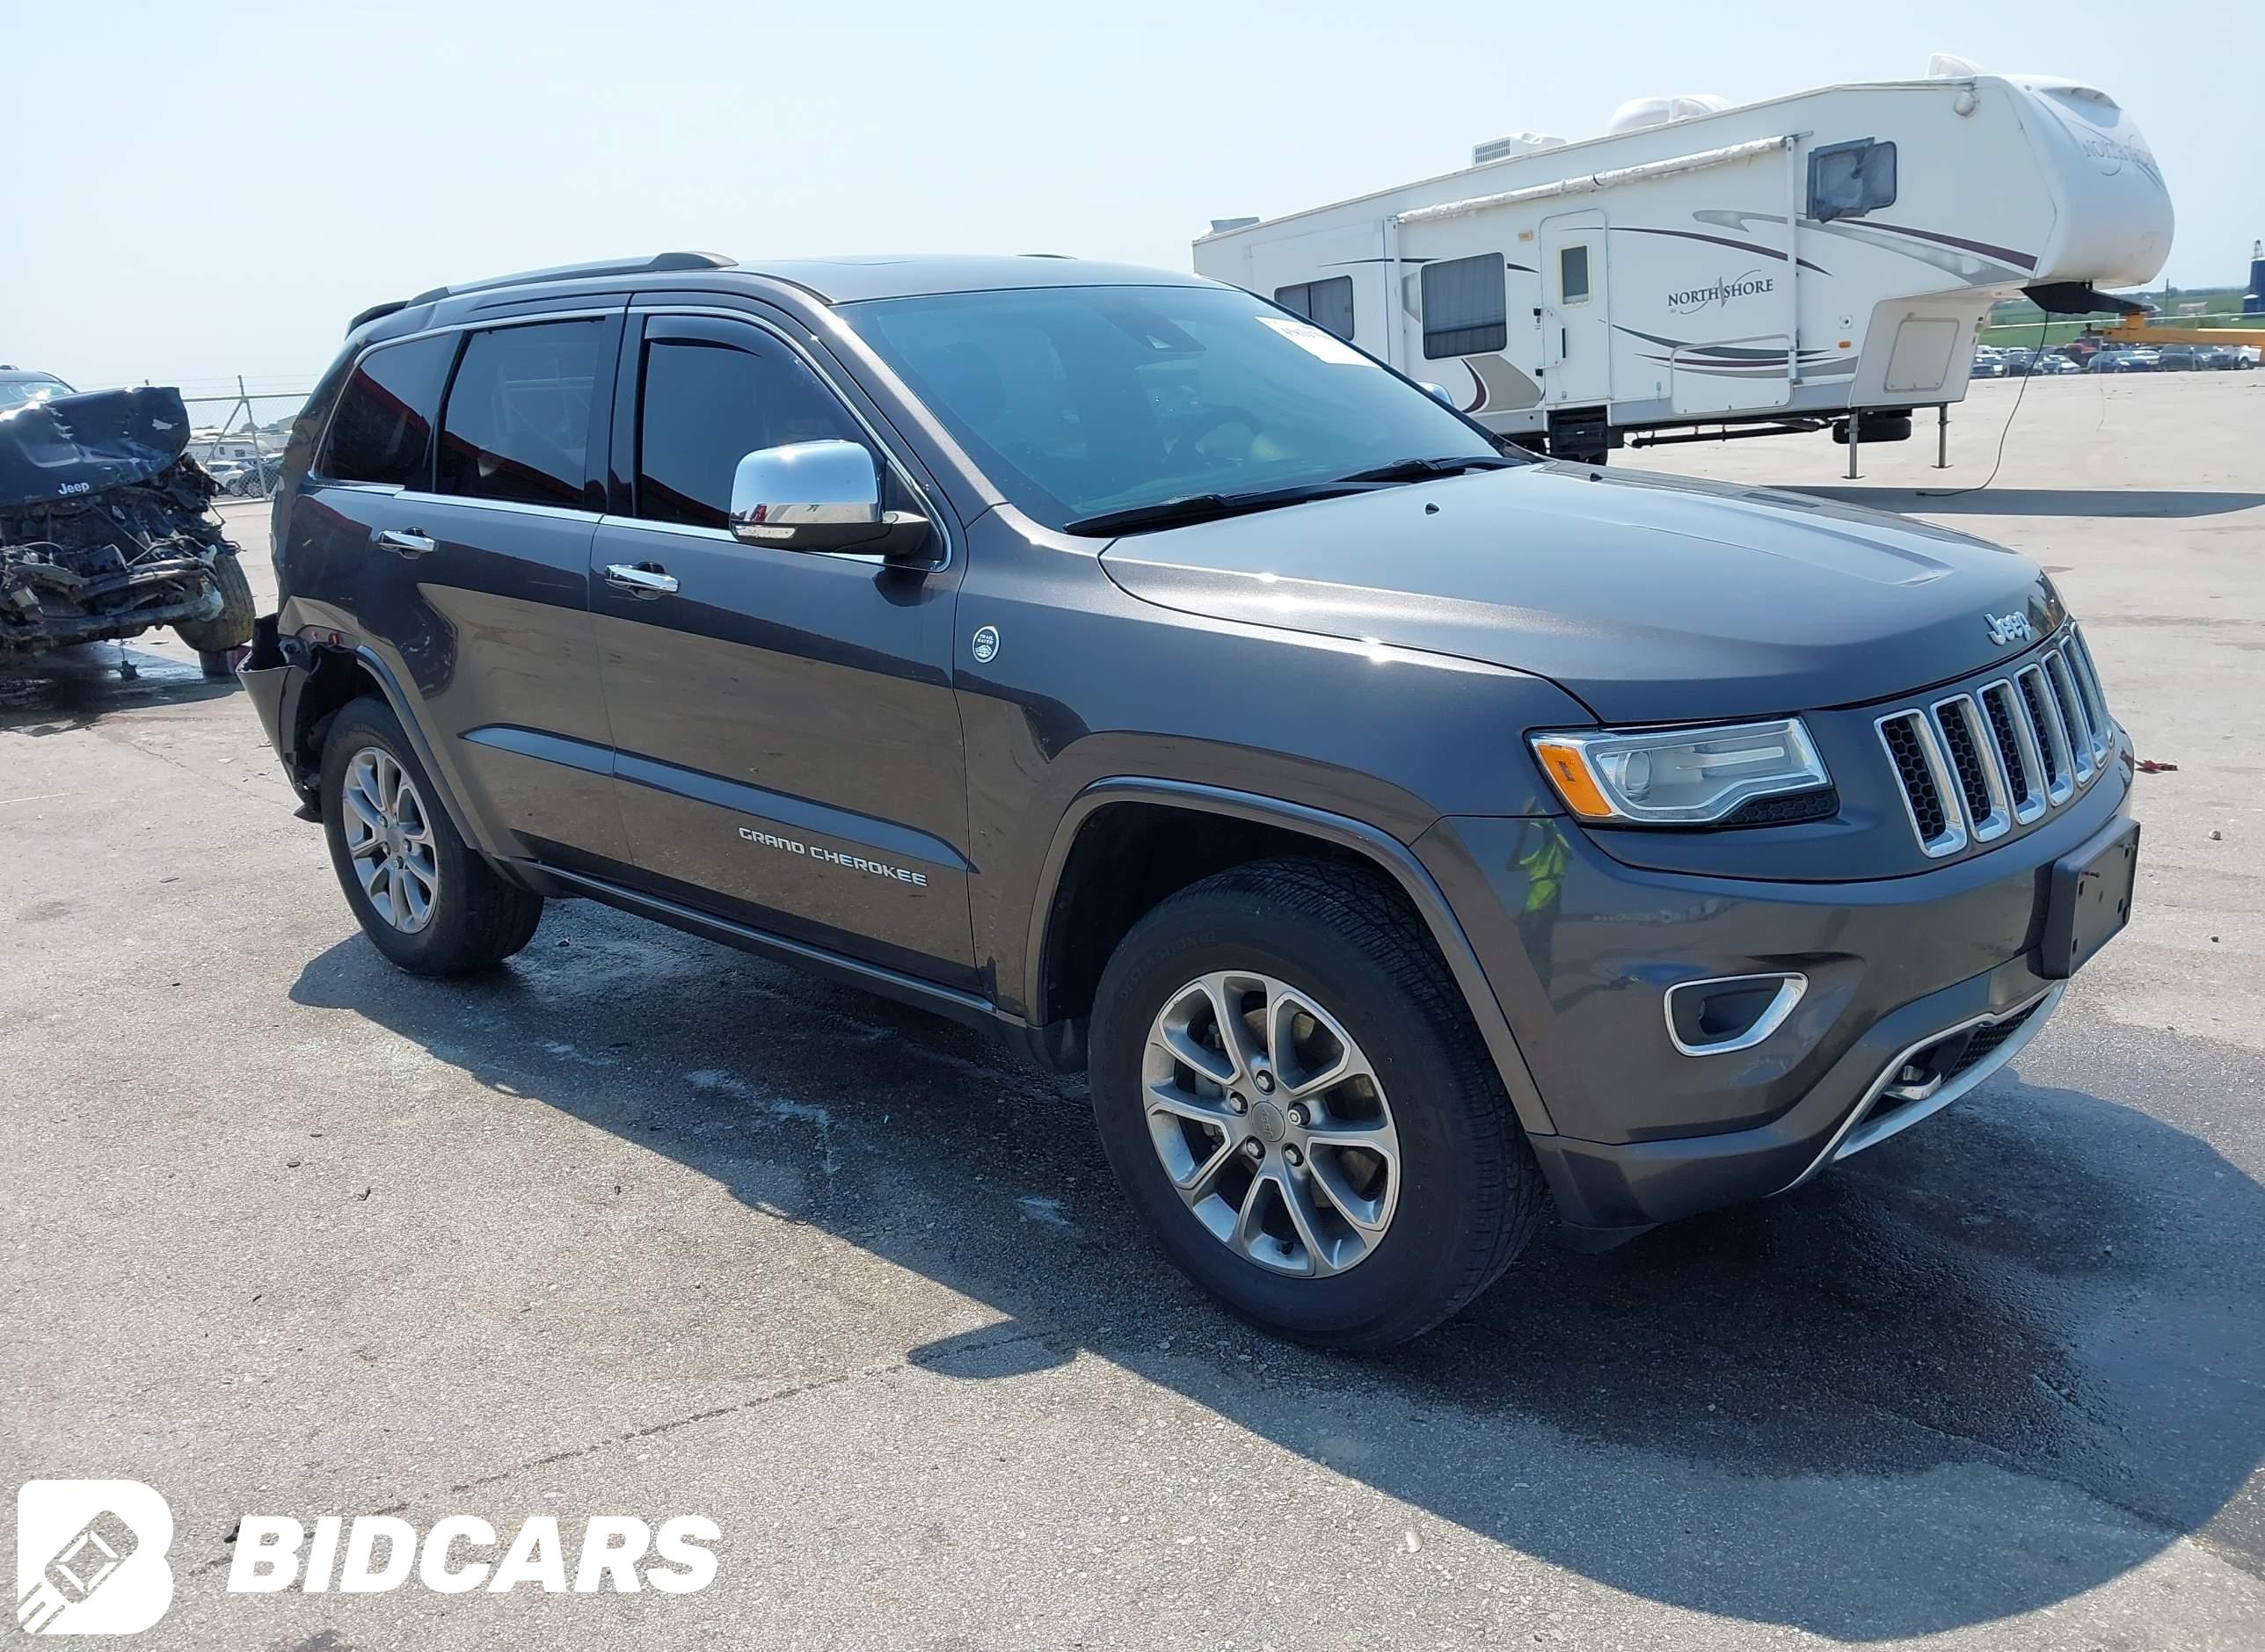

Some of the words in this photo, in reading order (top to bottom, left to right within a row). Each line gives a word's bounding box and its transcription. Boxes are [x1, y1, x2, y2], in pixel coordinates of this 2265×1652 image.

[1668, 287, 1719, 307] NORTH
[1723, 278, 1773, 299] SHORE
[57, 482, 90, 495] Jeep
[1984, 611, 2031, 646] Jeep
[738, 826, 805, 855] GRAND
[810, 846, 929, 887] CHEROKEE
